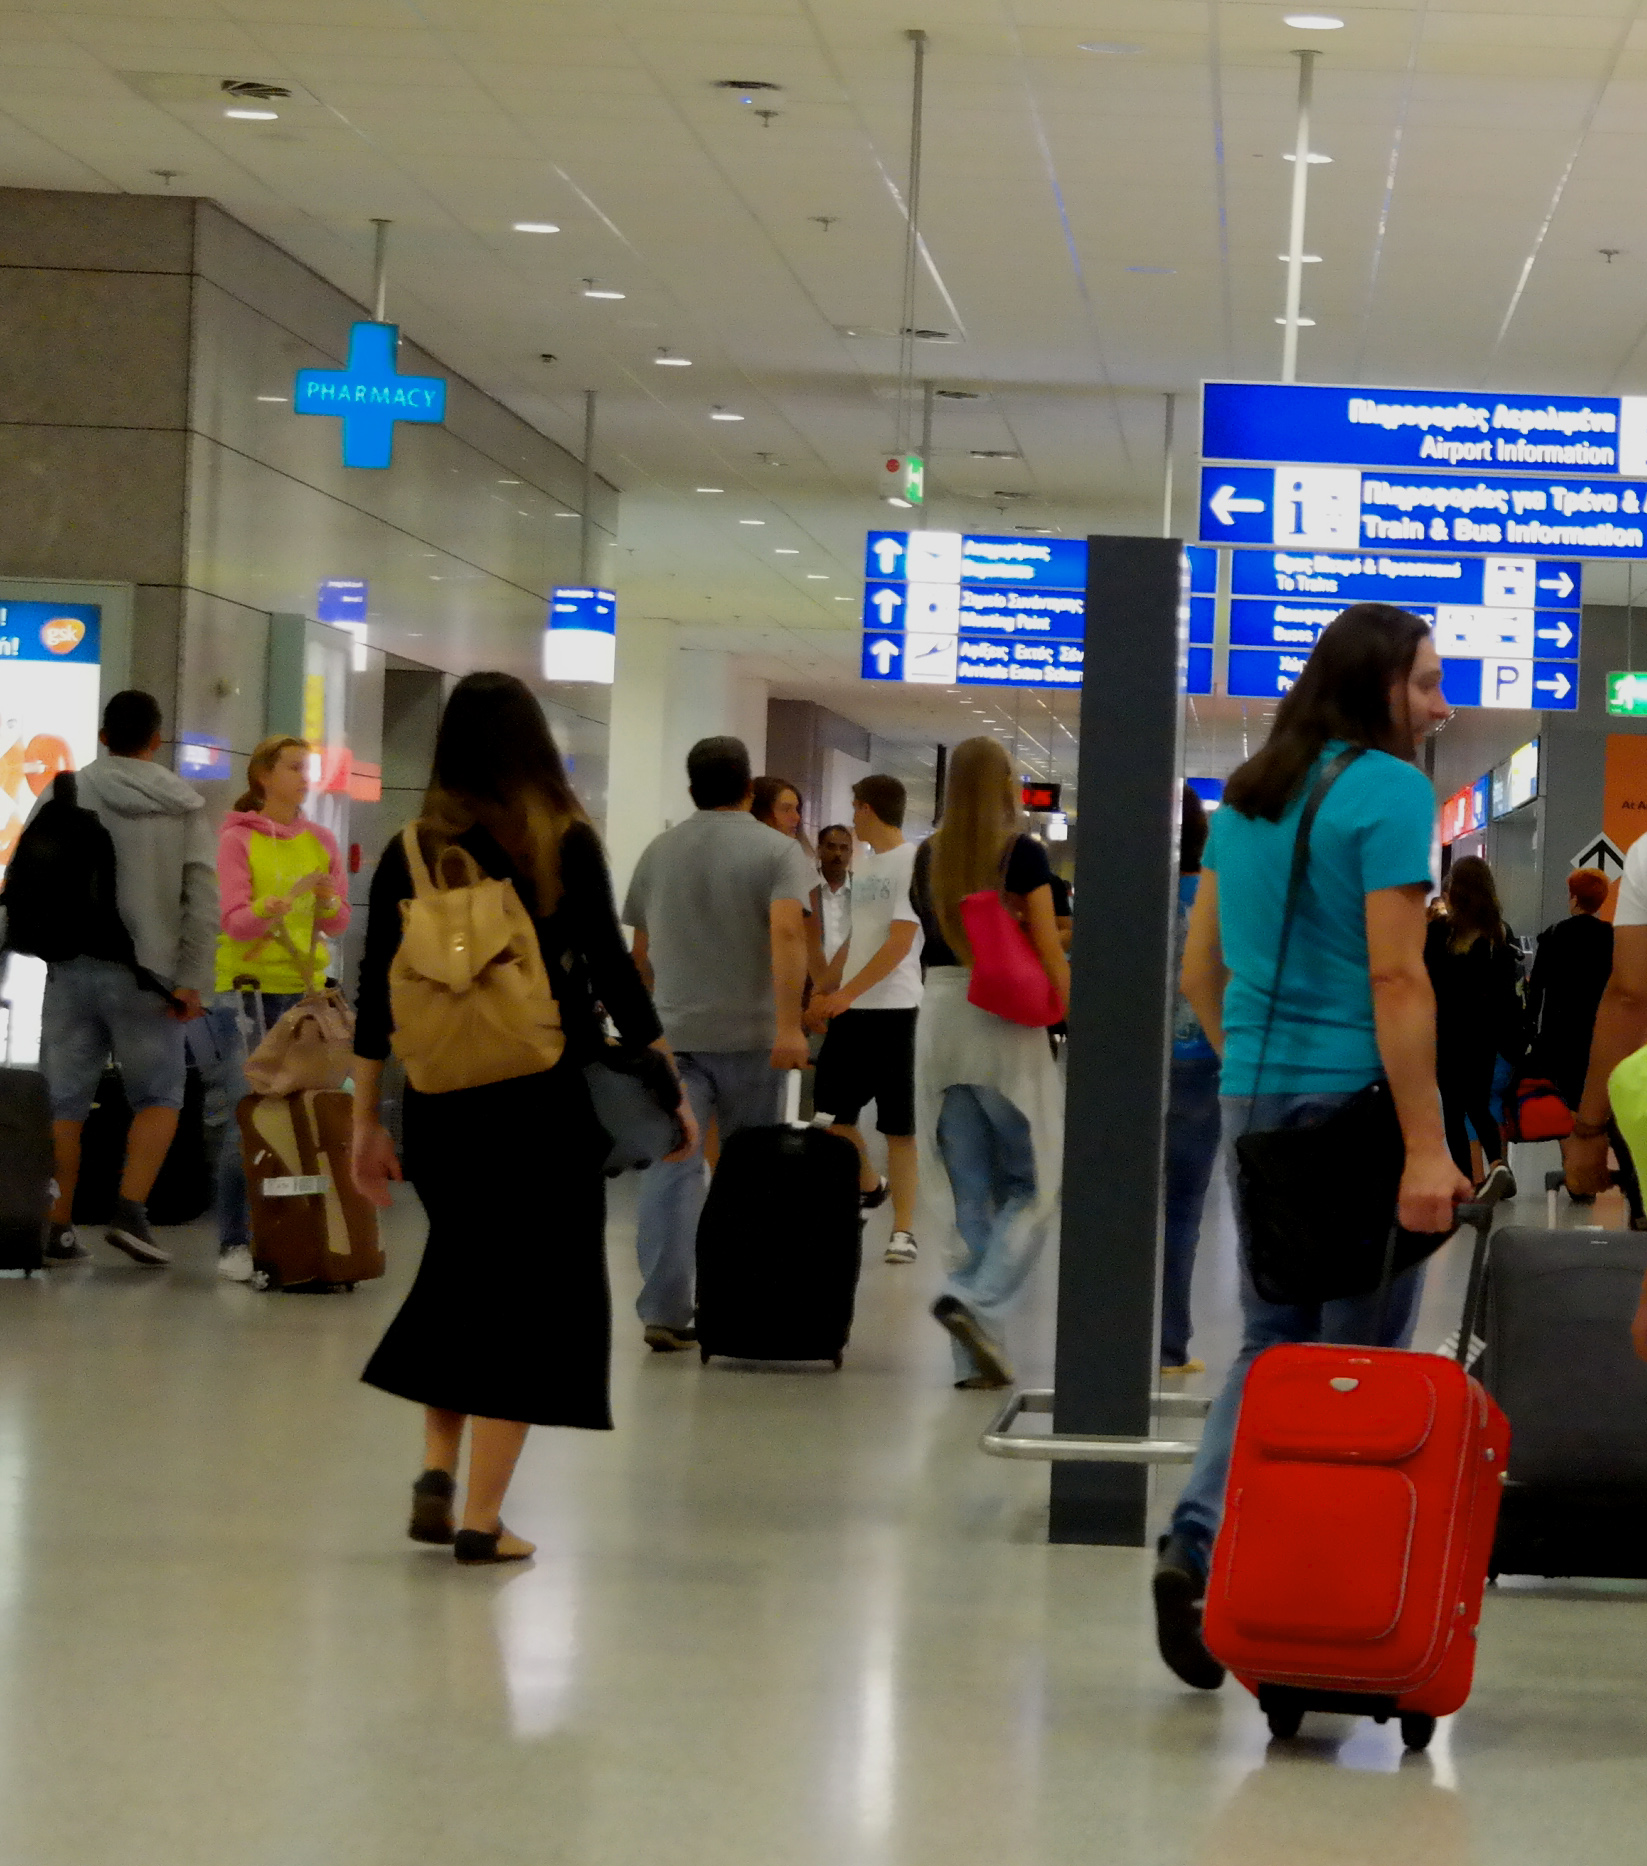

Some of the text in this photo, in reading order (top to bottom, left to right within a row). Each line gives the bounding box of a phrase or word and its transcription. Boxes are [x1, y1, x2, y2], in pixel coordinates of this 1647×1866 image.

[307, 381, 437, 408] PHARMACY
[1420, 434, 1615, 466] Airport Information
[1550, 486, 1618, 517] Τρένα
[1621, 489, 1641, 514] &
[1362, 514, 1643, 548] Train & Bus Information
[46, 624, 79, 647] gsk
